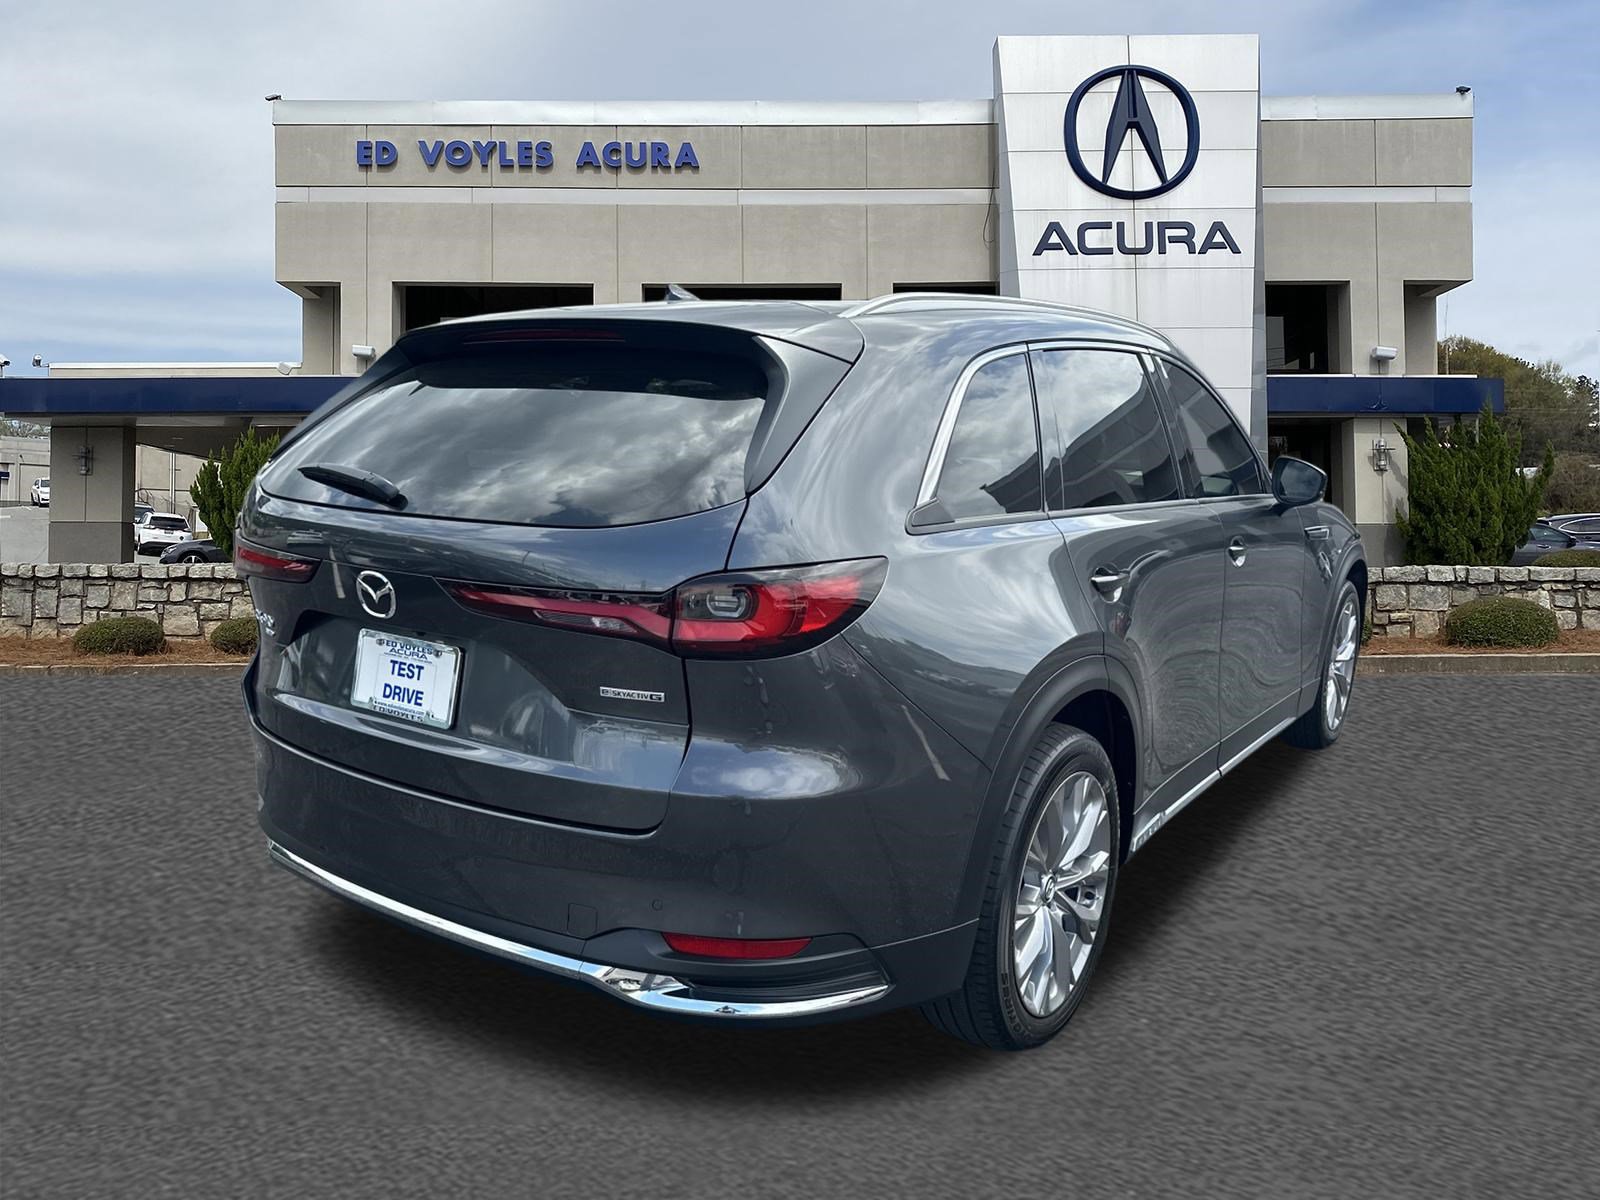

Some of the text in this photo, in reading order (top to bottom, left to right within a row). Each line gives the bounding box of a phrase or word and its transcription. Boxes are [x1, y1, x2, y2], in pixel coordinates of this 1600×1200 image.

[356, 140, 700, 167] ED VOYLES ACURA
[1032, 221, 1242, 256] ACURA
[386, 640, 433, 655] ED VOYLES
[389, 648, 428, 660] ACURA
[390, 659, 424, 680] TEST
[382, 683, 424, 706] DRIVE
